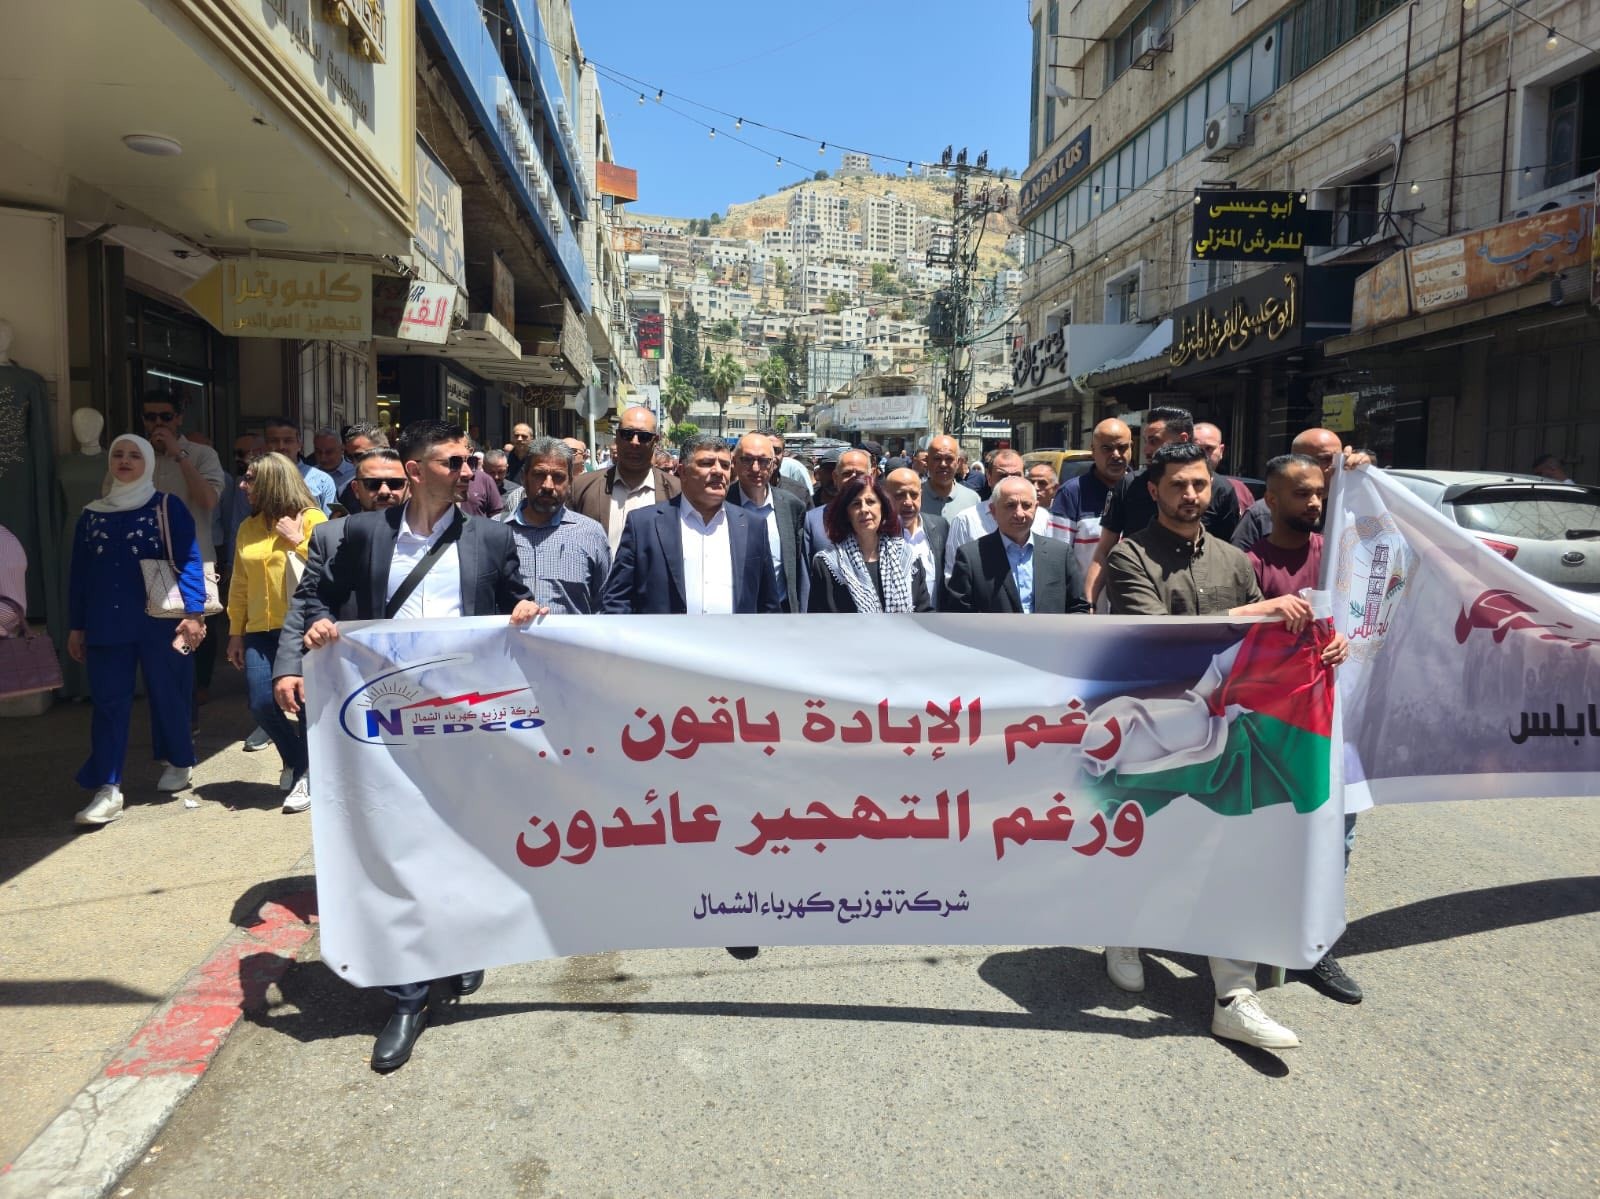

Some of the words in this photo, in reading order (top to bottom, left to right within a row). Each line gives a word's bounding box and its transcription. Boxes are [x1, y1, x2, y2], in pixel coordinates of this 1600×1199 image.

[1022, 141, 1083, 209] ANDALUS
[1209, 198, 1269, 219] عيسى
[1271, 193, 1294, 219] أبو
[1195, 227, 1242, 258] المنزلي
[1242, 228, 1303, 254] للفرش
[227, 263, 363, 309] كليوبترا
[1268, 272, 1296, 341] أبو
[365, 708, 546, 738] NEDCO
[412, 711, 441, 725] الشمال
[444, 710, 478, 722] كهرباء
[482, 708, 507, 723] توزيع
[511, 706, 540, 718] شركة
[1509, 703, 1600, 747] ابلس
[621, 697, 781, 761] باقون
[802, 697, 982, 760] الإبادة
[1005, 698, 1121, 764] رغم
[516, 789, 721, 867] عائدون
[735, 789, 970, 855] التهجير
[992, 792, 1145, 860] ورغم
[693, 891, 759, 920] الشمال
[760, 891, 835, 920] كهرباء
[837, 890, 894, 924] توزيع
[895, 889, 970, 918] شركة
